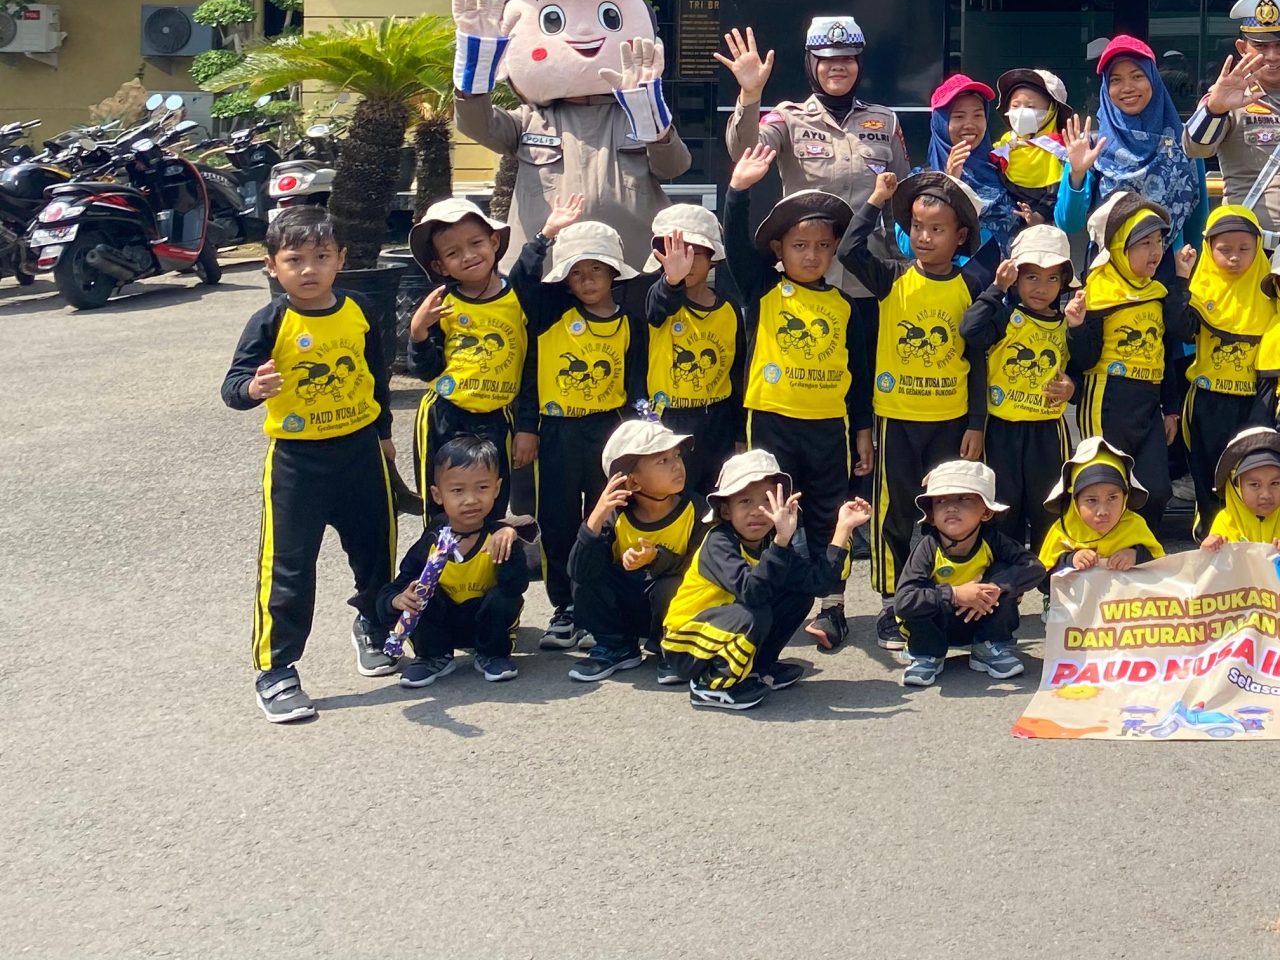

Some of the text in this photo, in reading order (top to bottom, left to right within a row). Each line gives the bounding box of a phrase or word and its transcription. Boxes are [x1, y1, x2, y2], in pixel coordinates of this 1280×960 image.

[689, 0, 704, 9] TRI
[526, 135, 555, 145] POLIS
[802, 129, 826, 141] AYU
[858, 132, 890, 143] POLRI
[785, 366, 806, 380] PAUD
[807, 368, 826, 381] NUSA
[1131, 366, 1151, 379] PAUD
[457, 378, 480, 390] PAUD
[480, 379, 499, 392] NUSA
[924, 376, 940, 388] NUSA
[1215, 378, 1232, 390] PAUD
[1007, 388, 1025, 403] PAUD
[1024, 393, 1043, 407] NUSA
[310, 410, 333, 425] PAUD
[335, 406, 356, 421] NUSA
[1102, 599, 1183, 621] WISATA
[1188, 590, 1277, 617] EDUKASI
[1067, 630, 1115, 649] DAN
[1118, 624, 1205, 648] ATURAN
[1210, 611, 1277, 639] JALAN
[1050, 660, 1158, 685] PAUD
[1162, 637, 1256, 683] NUSA
